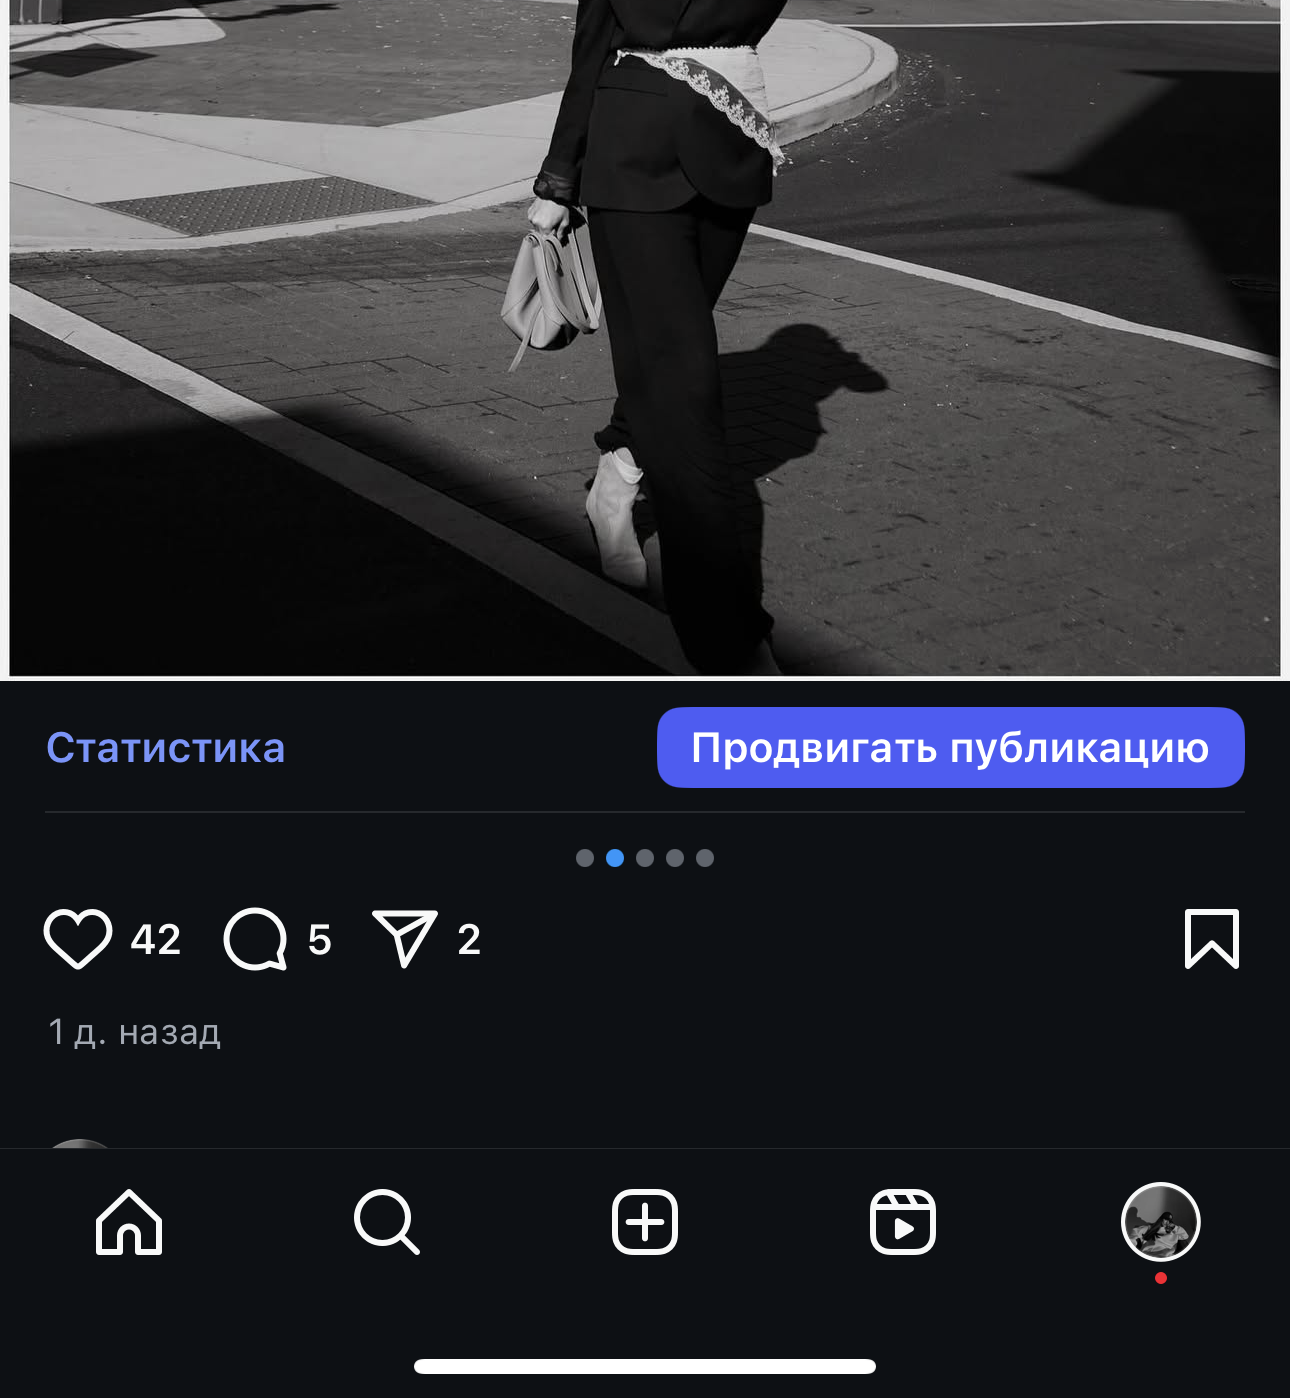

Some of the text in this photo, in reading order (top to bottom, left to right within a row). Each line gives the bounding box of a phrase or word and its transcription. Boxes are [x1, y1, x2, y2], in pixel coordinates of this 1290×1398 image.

[46, 730, 285, 764] Статистика
[693, 729, 1209, 771] Продвигать публикацию
[130, 922, 181, 955] 42
[308, 923, 332, 956] 5
[458, 922, 481, 955] 2
[49, 1017, 221, 1050] 1 д. назад
